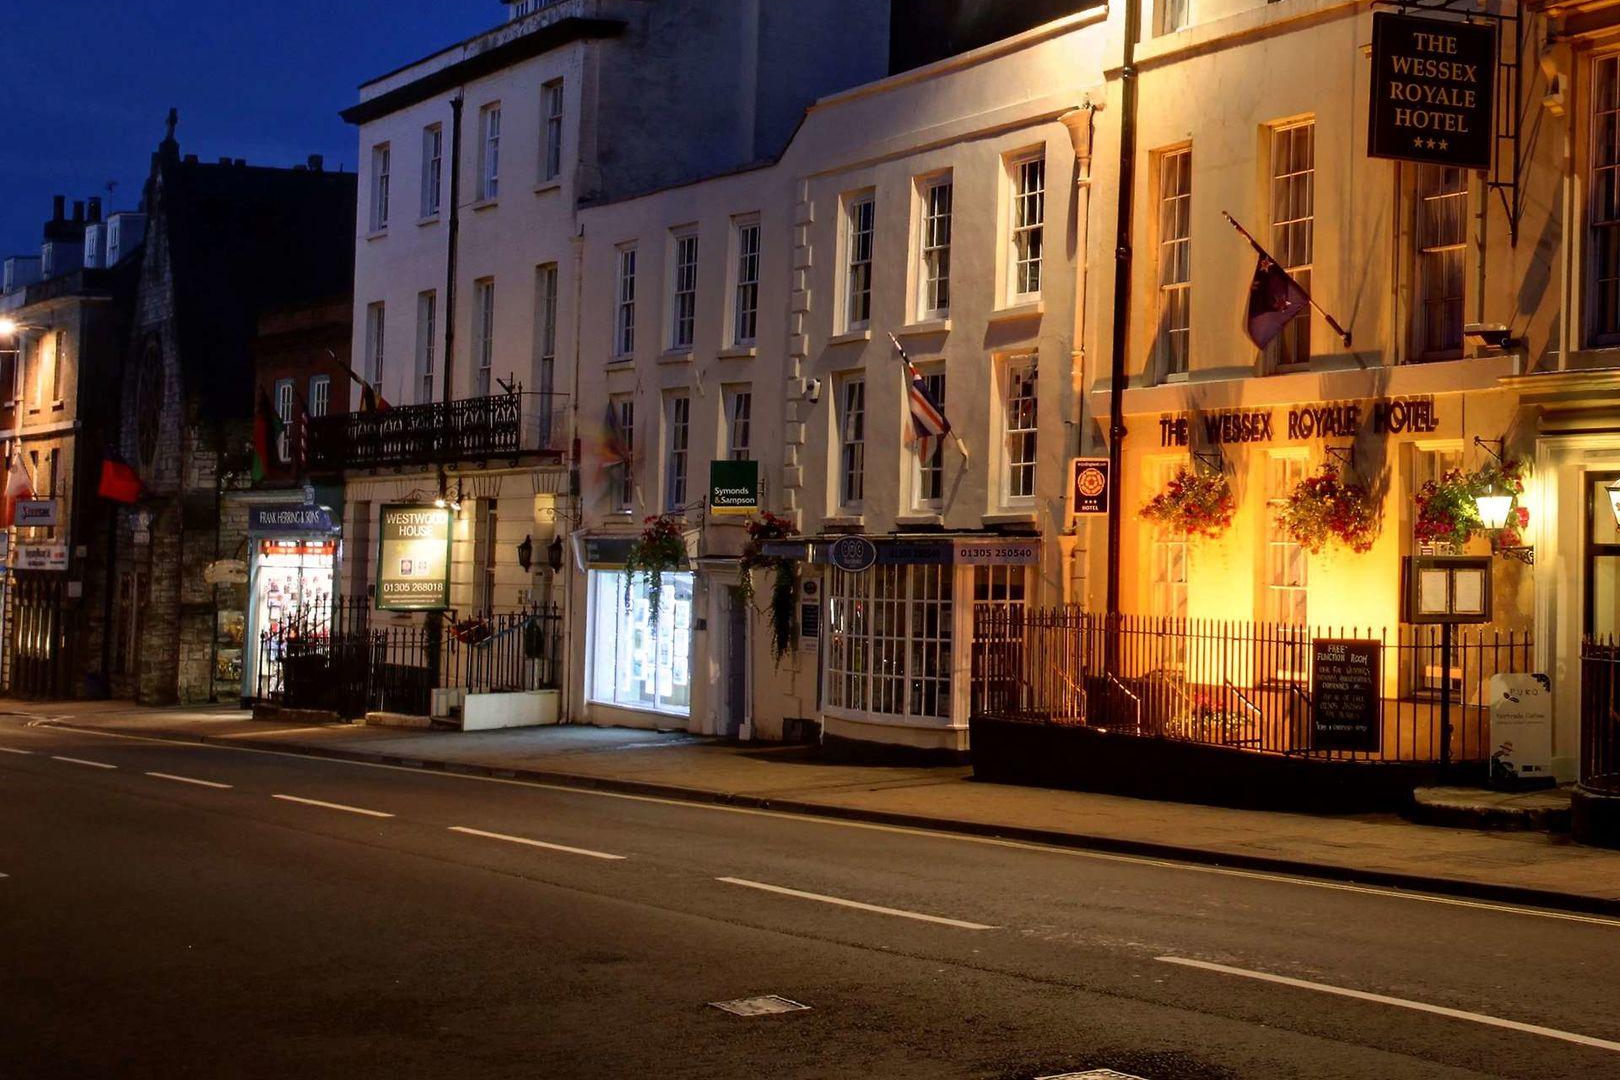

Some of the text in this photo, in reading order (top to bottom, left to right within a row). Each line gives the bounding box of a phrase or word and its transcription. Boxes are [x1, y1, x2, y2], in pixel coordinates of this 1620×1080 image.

[1413, 32, 1457, 54] THE
[1391, 55, 1477, 82] WESSEX
[1389, 81, 1476, 107] ROYALE
[1394, 107, 1470, 133] HOTEL
[1159, 400, 1440, 447] THE WESSEX ROYALE HOTEL
[714, 487, 749, 496] Symonds
[399, 525, 433, 537] HOUSE
[960, 548, 1032, 558] 01305 250540
[383, 583, 410, 592] 01305
